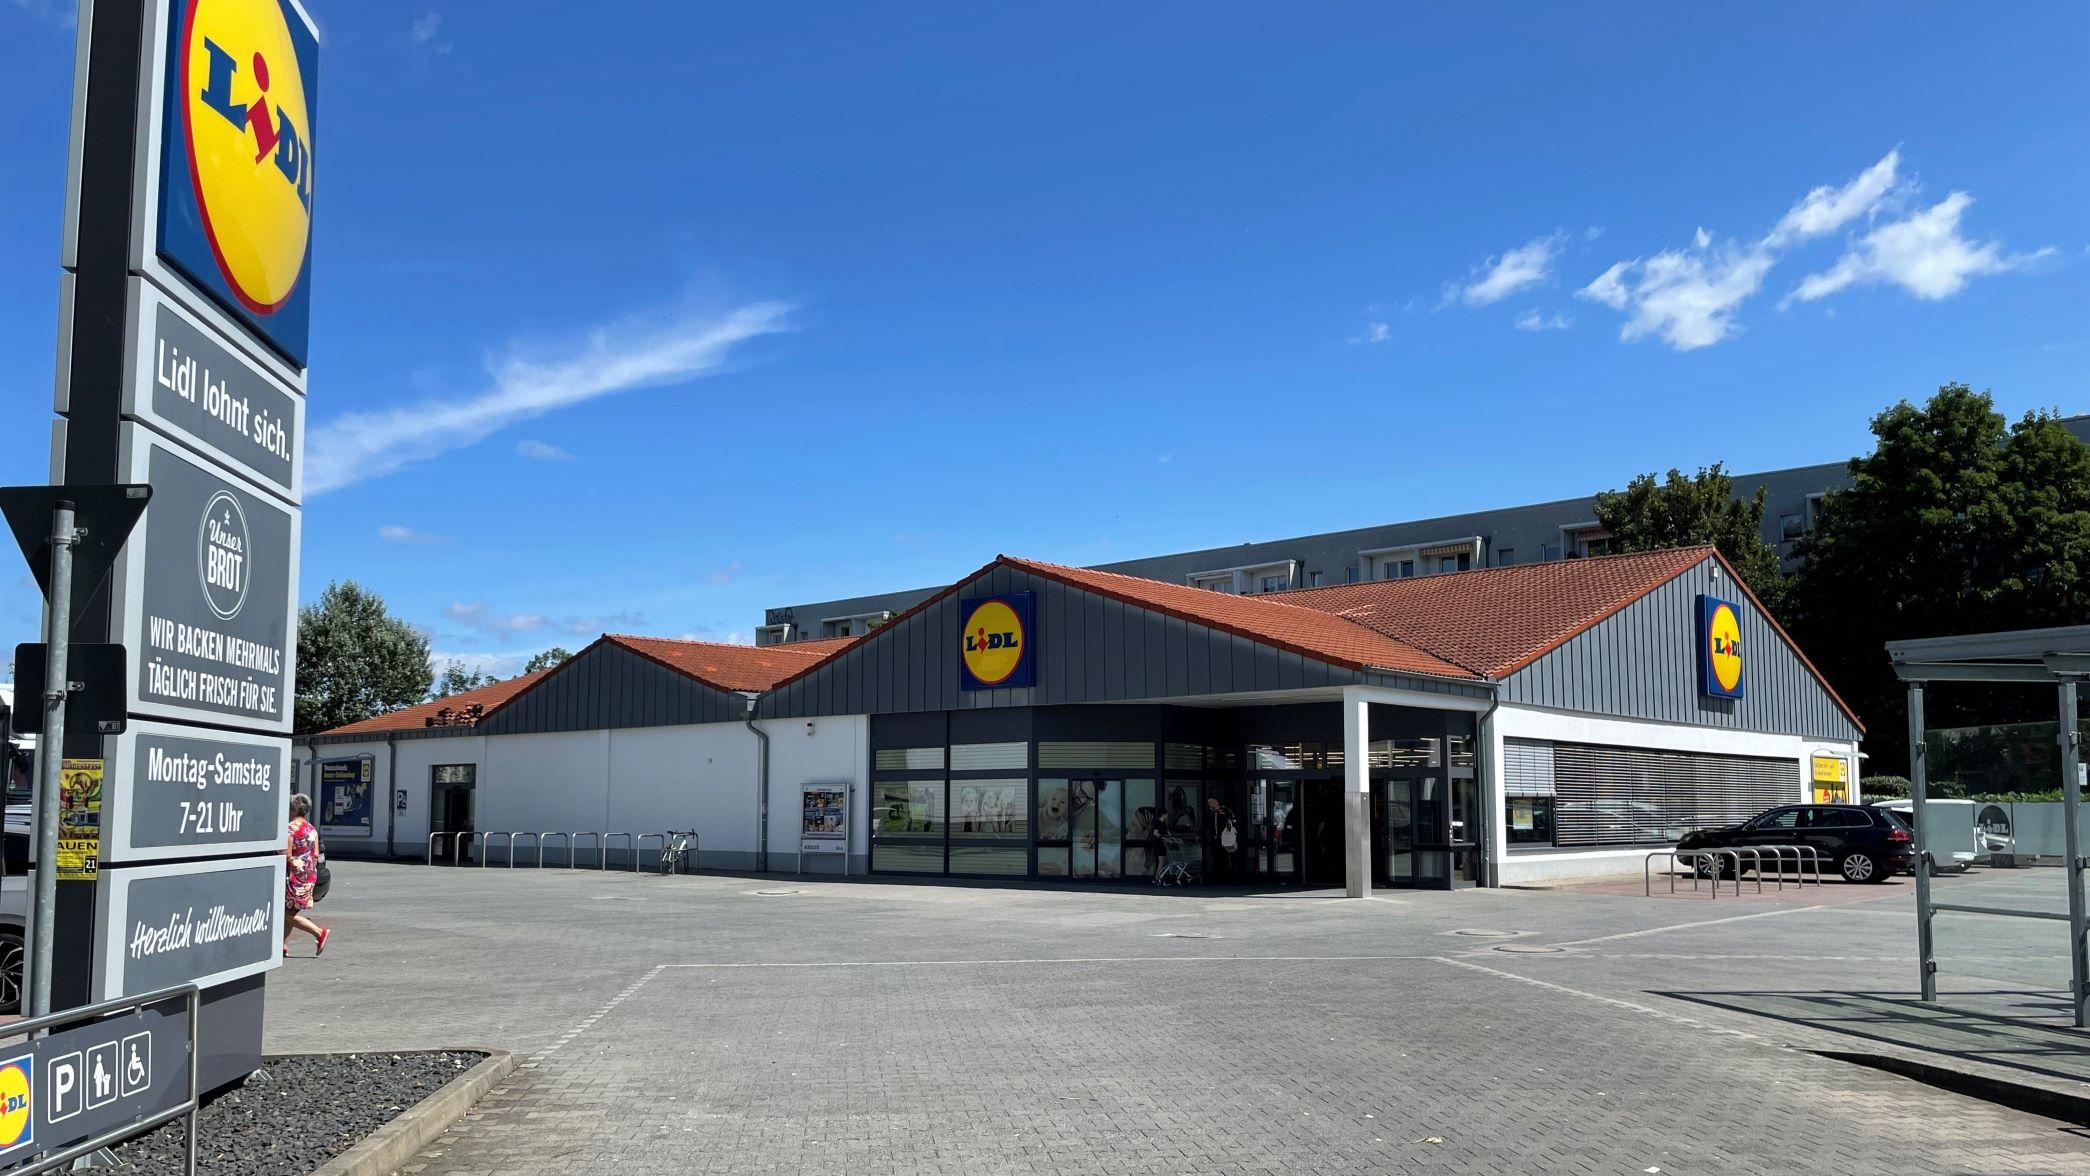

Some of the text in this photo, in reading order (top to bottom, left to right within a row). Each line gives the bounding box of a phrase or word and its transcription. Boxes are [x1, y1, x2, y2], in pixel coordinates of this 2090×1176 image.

[158, 338, 290, 462] Lidl lohnt sich.
[208, 519, 243, 553] Unser
[207, 545, 243, 592] BROT
[150, 615, 280, 675] WIR BACKEN MEHRMALS
[148, 656, 277, 714] TÄGLICH FRISCH FÜR SIE.
[148, 747, 271, 792] Montag-Samstag
[179, 801, 244, 834] 7-21 Uhr
[57, 841, 98, 850] AUEN
[85, 859, 96, 869] 21
[130, 902, 270, 959] Herzlich willkommen!
[56, 1063, 75, 1113] P
